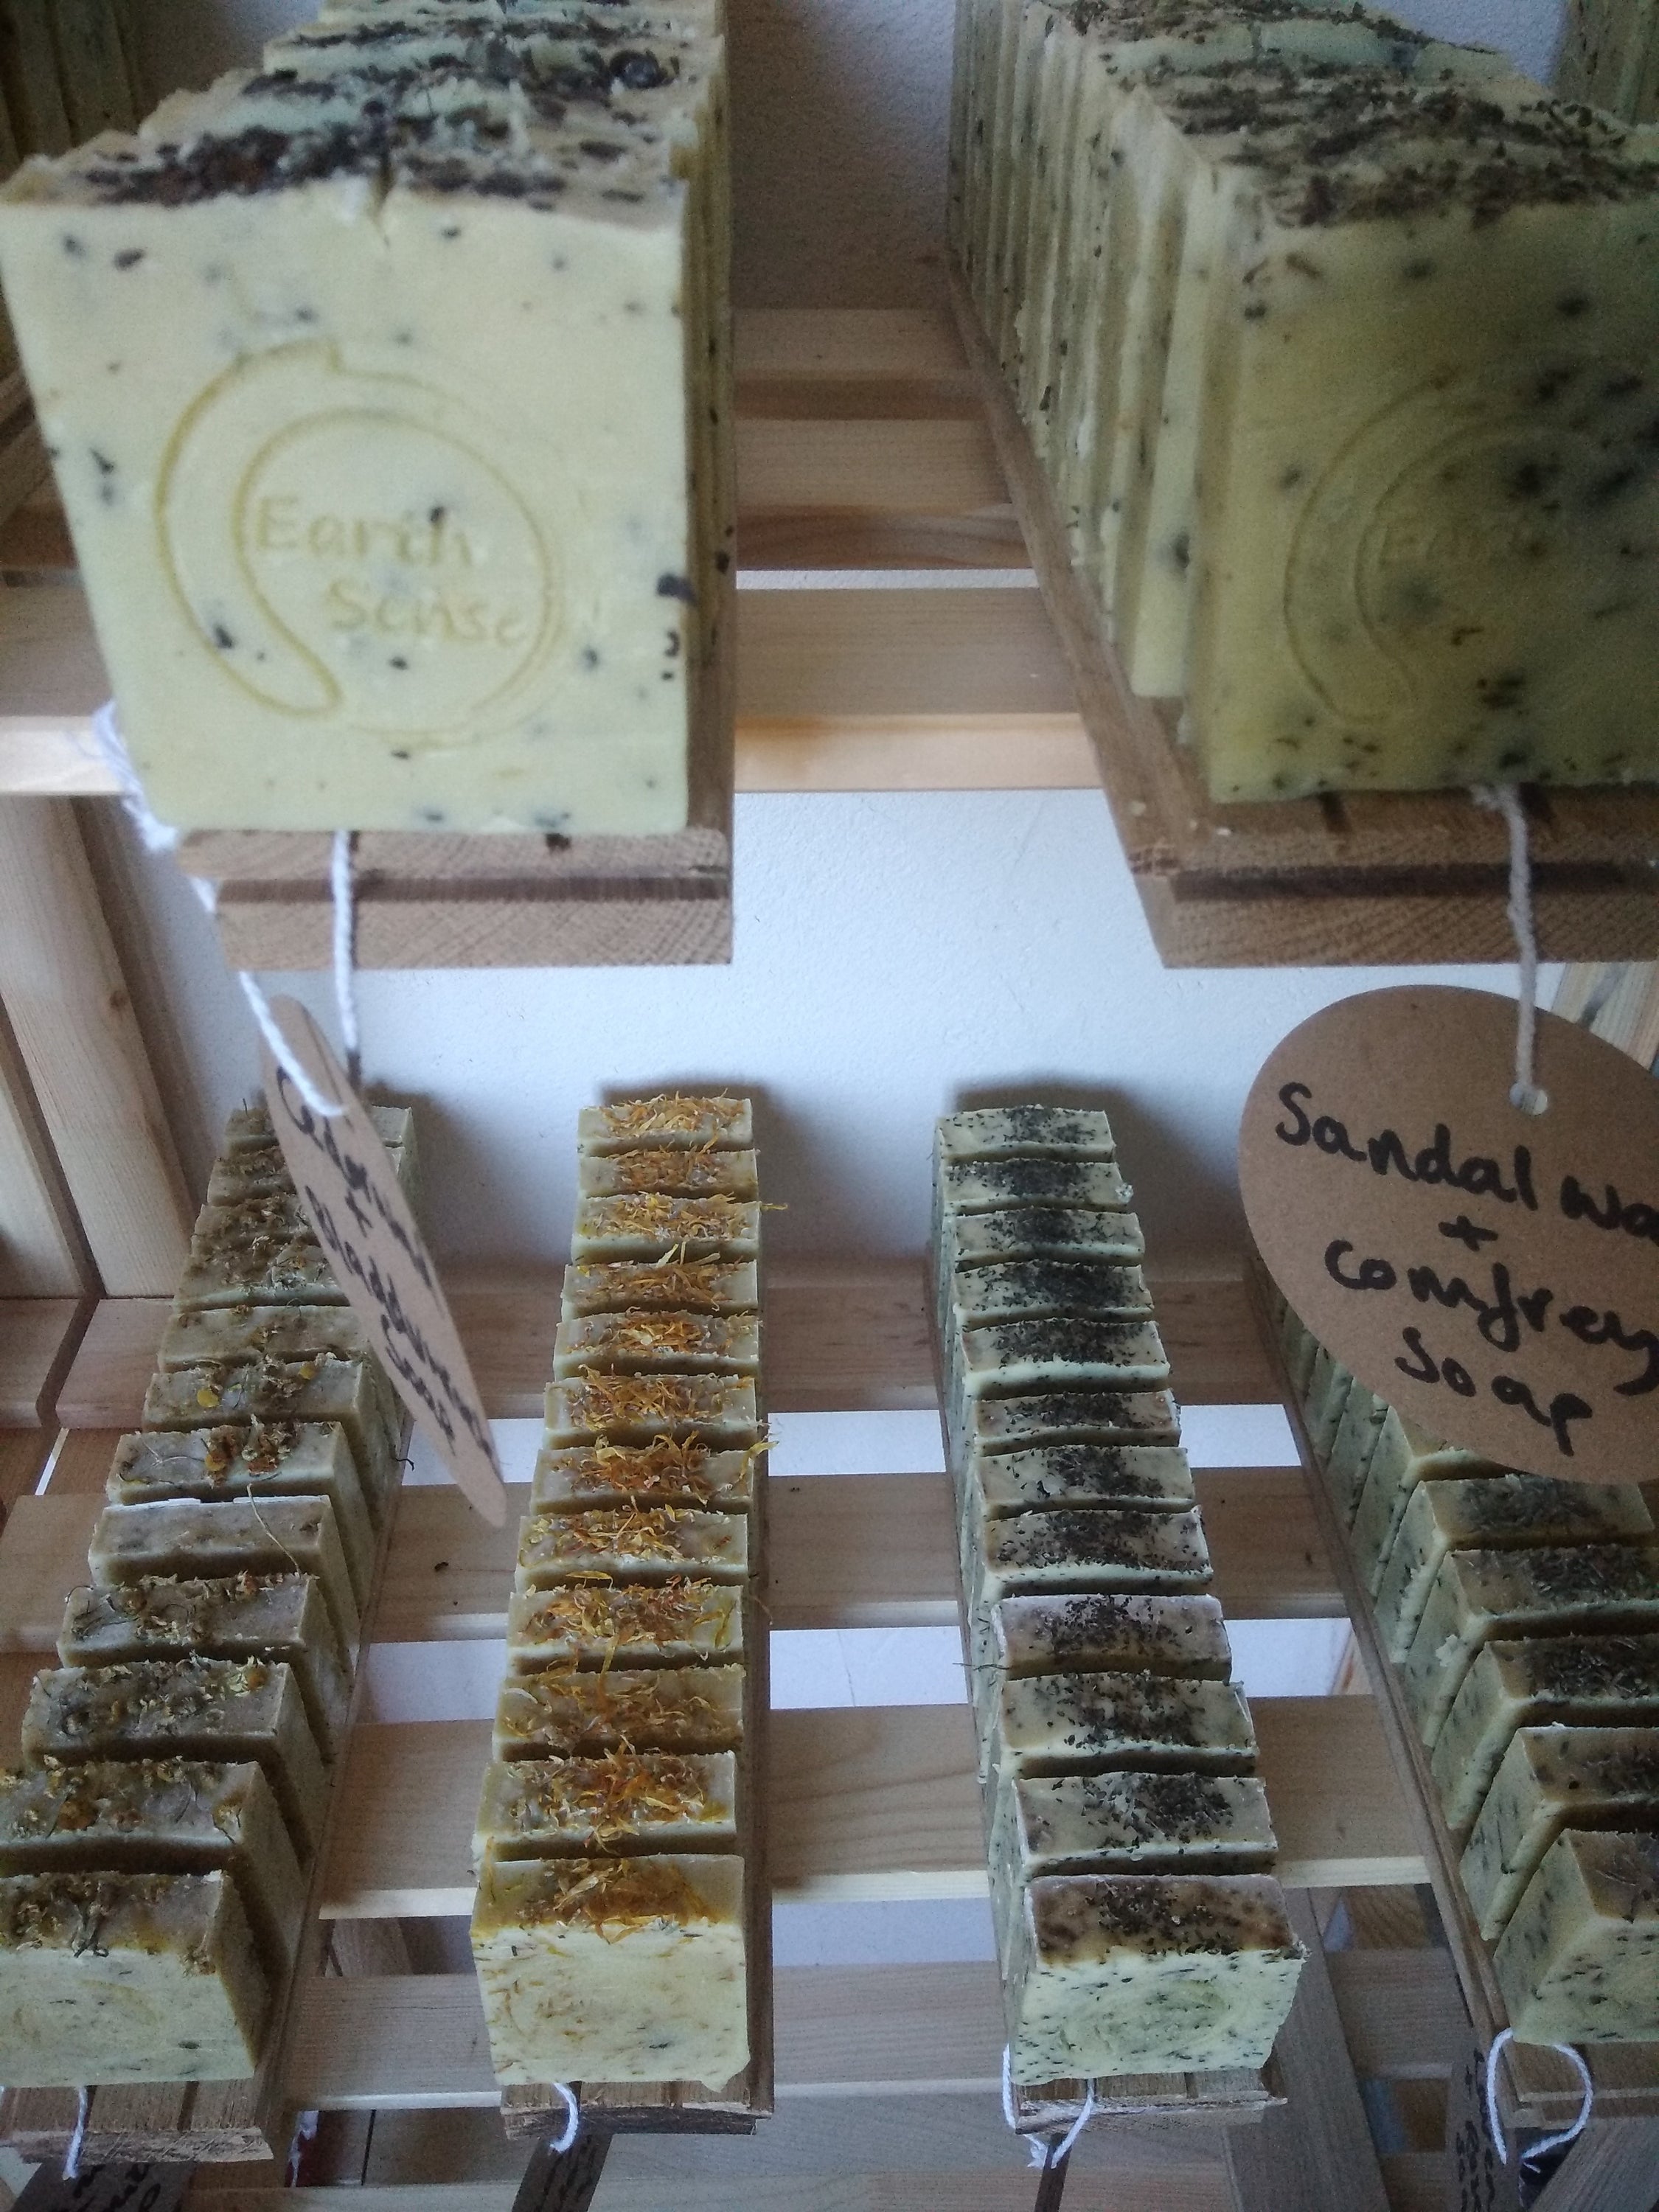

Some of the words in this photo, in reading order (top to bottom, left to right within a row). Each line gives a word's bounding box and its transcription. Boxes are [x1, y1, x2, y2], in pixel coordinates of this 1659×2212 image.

[255, 494, 473, 569] Earth
[324, 577, 529, 649] Sense
[1275, 1081, 1539, 1211] Sandal
[1395, 1326, 1593, 1458] Soap
